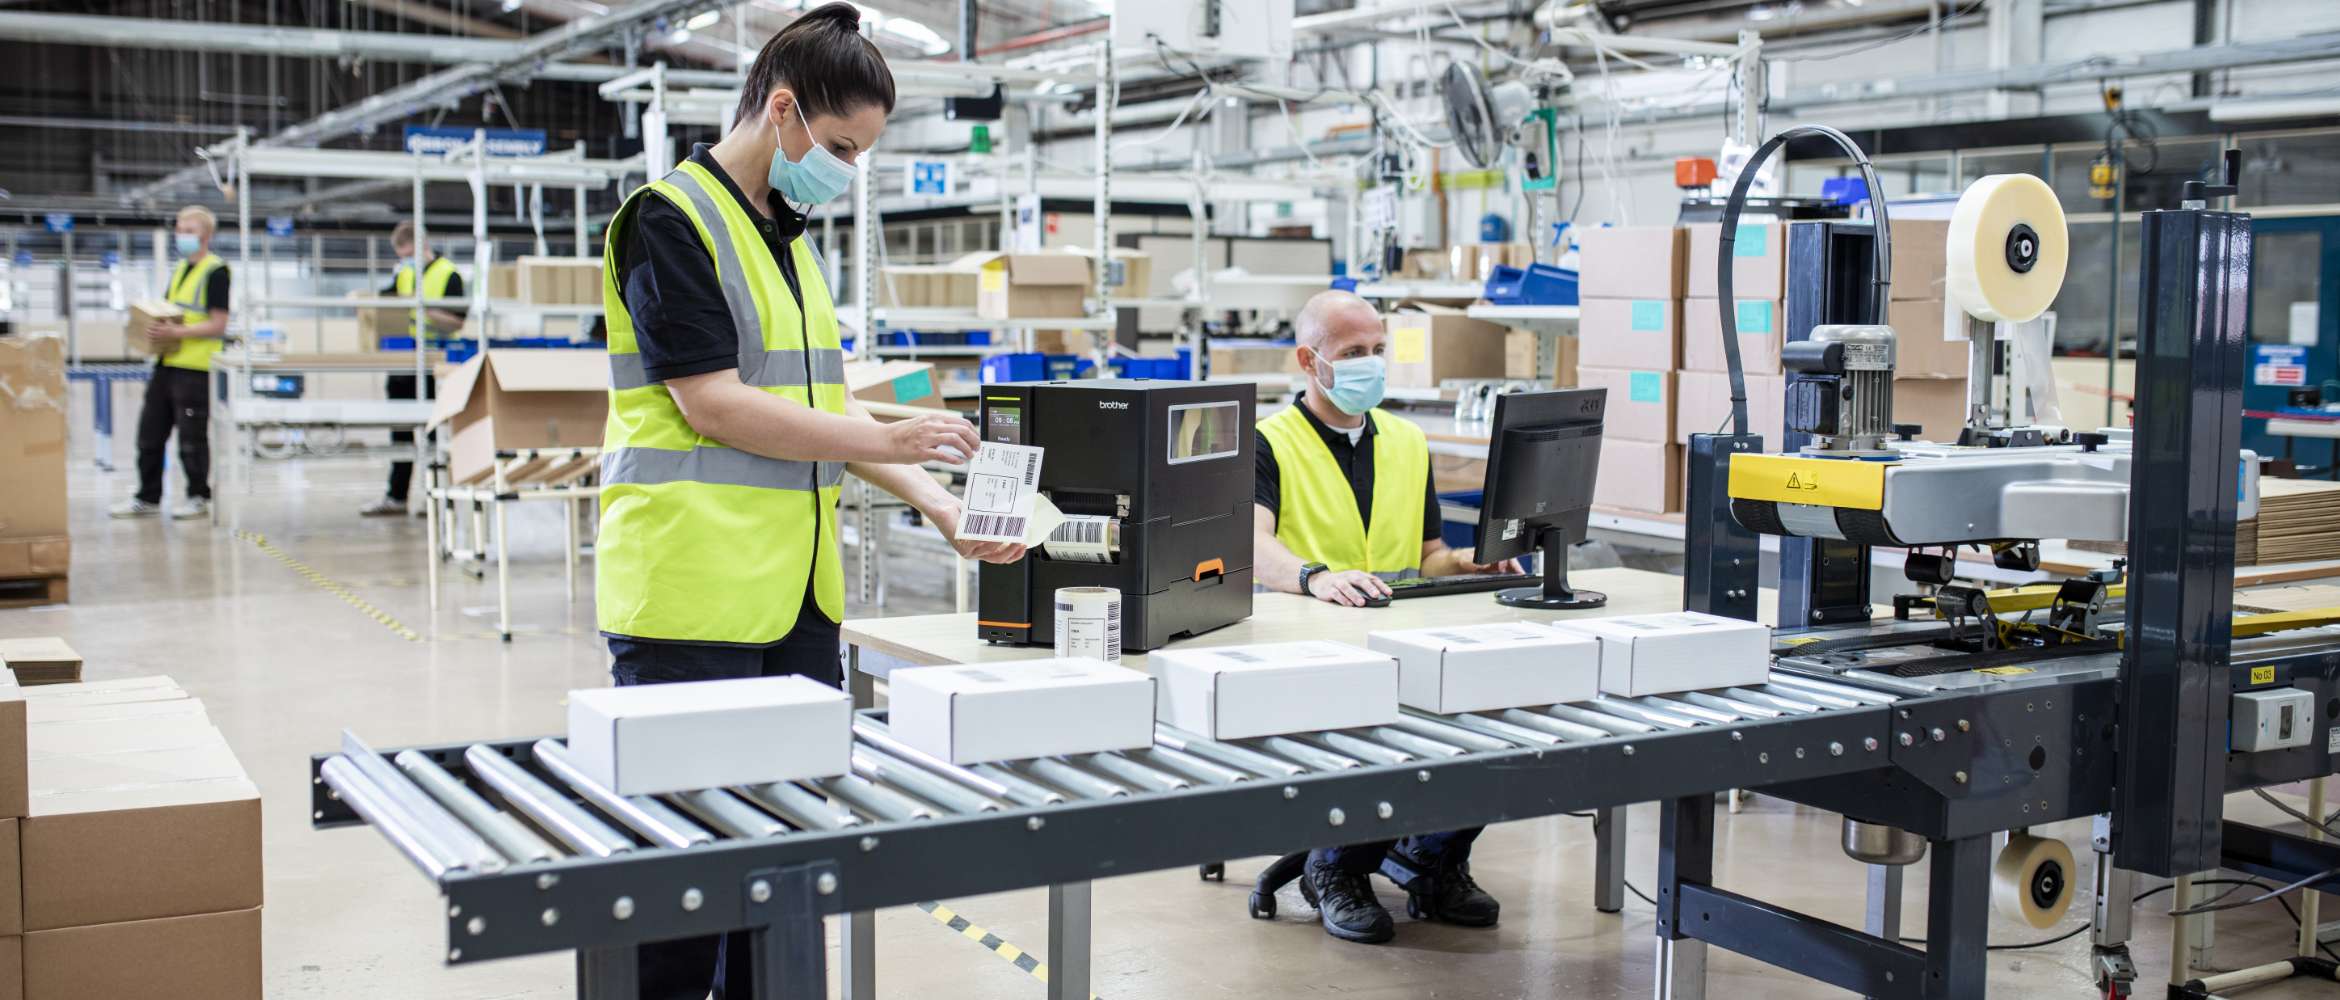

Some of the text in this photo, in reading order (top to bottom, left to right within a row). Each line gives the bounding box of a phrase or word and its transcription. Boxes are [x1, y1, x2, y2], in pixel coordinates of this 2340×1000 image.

[1099, 400, 1129, 409] brother
[2253, 670, 2272, 680] No 03
